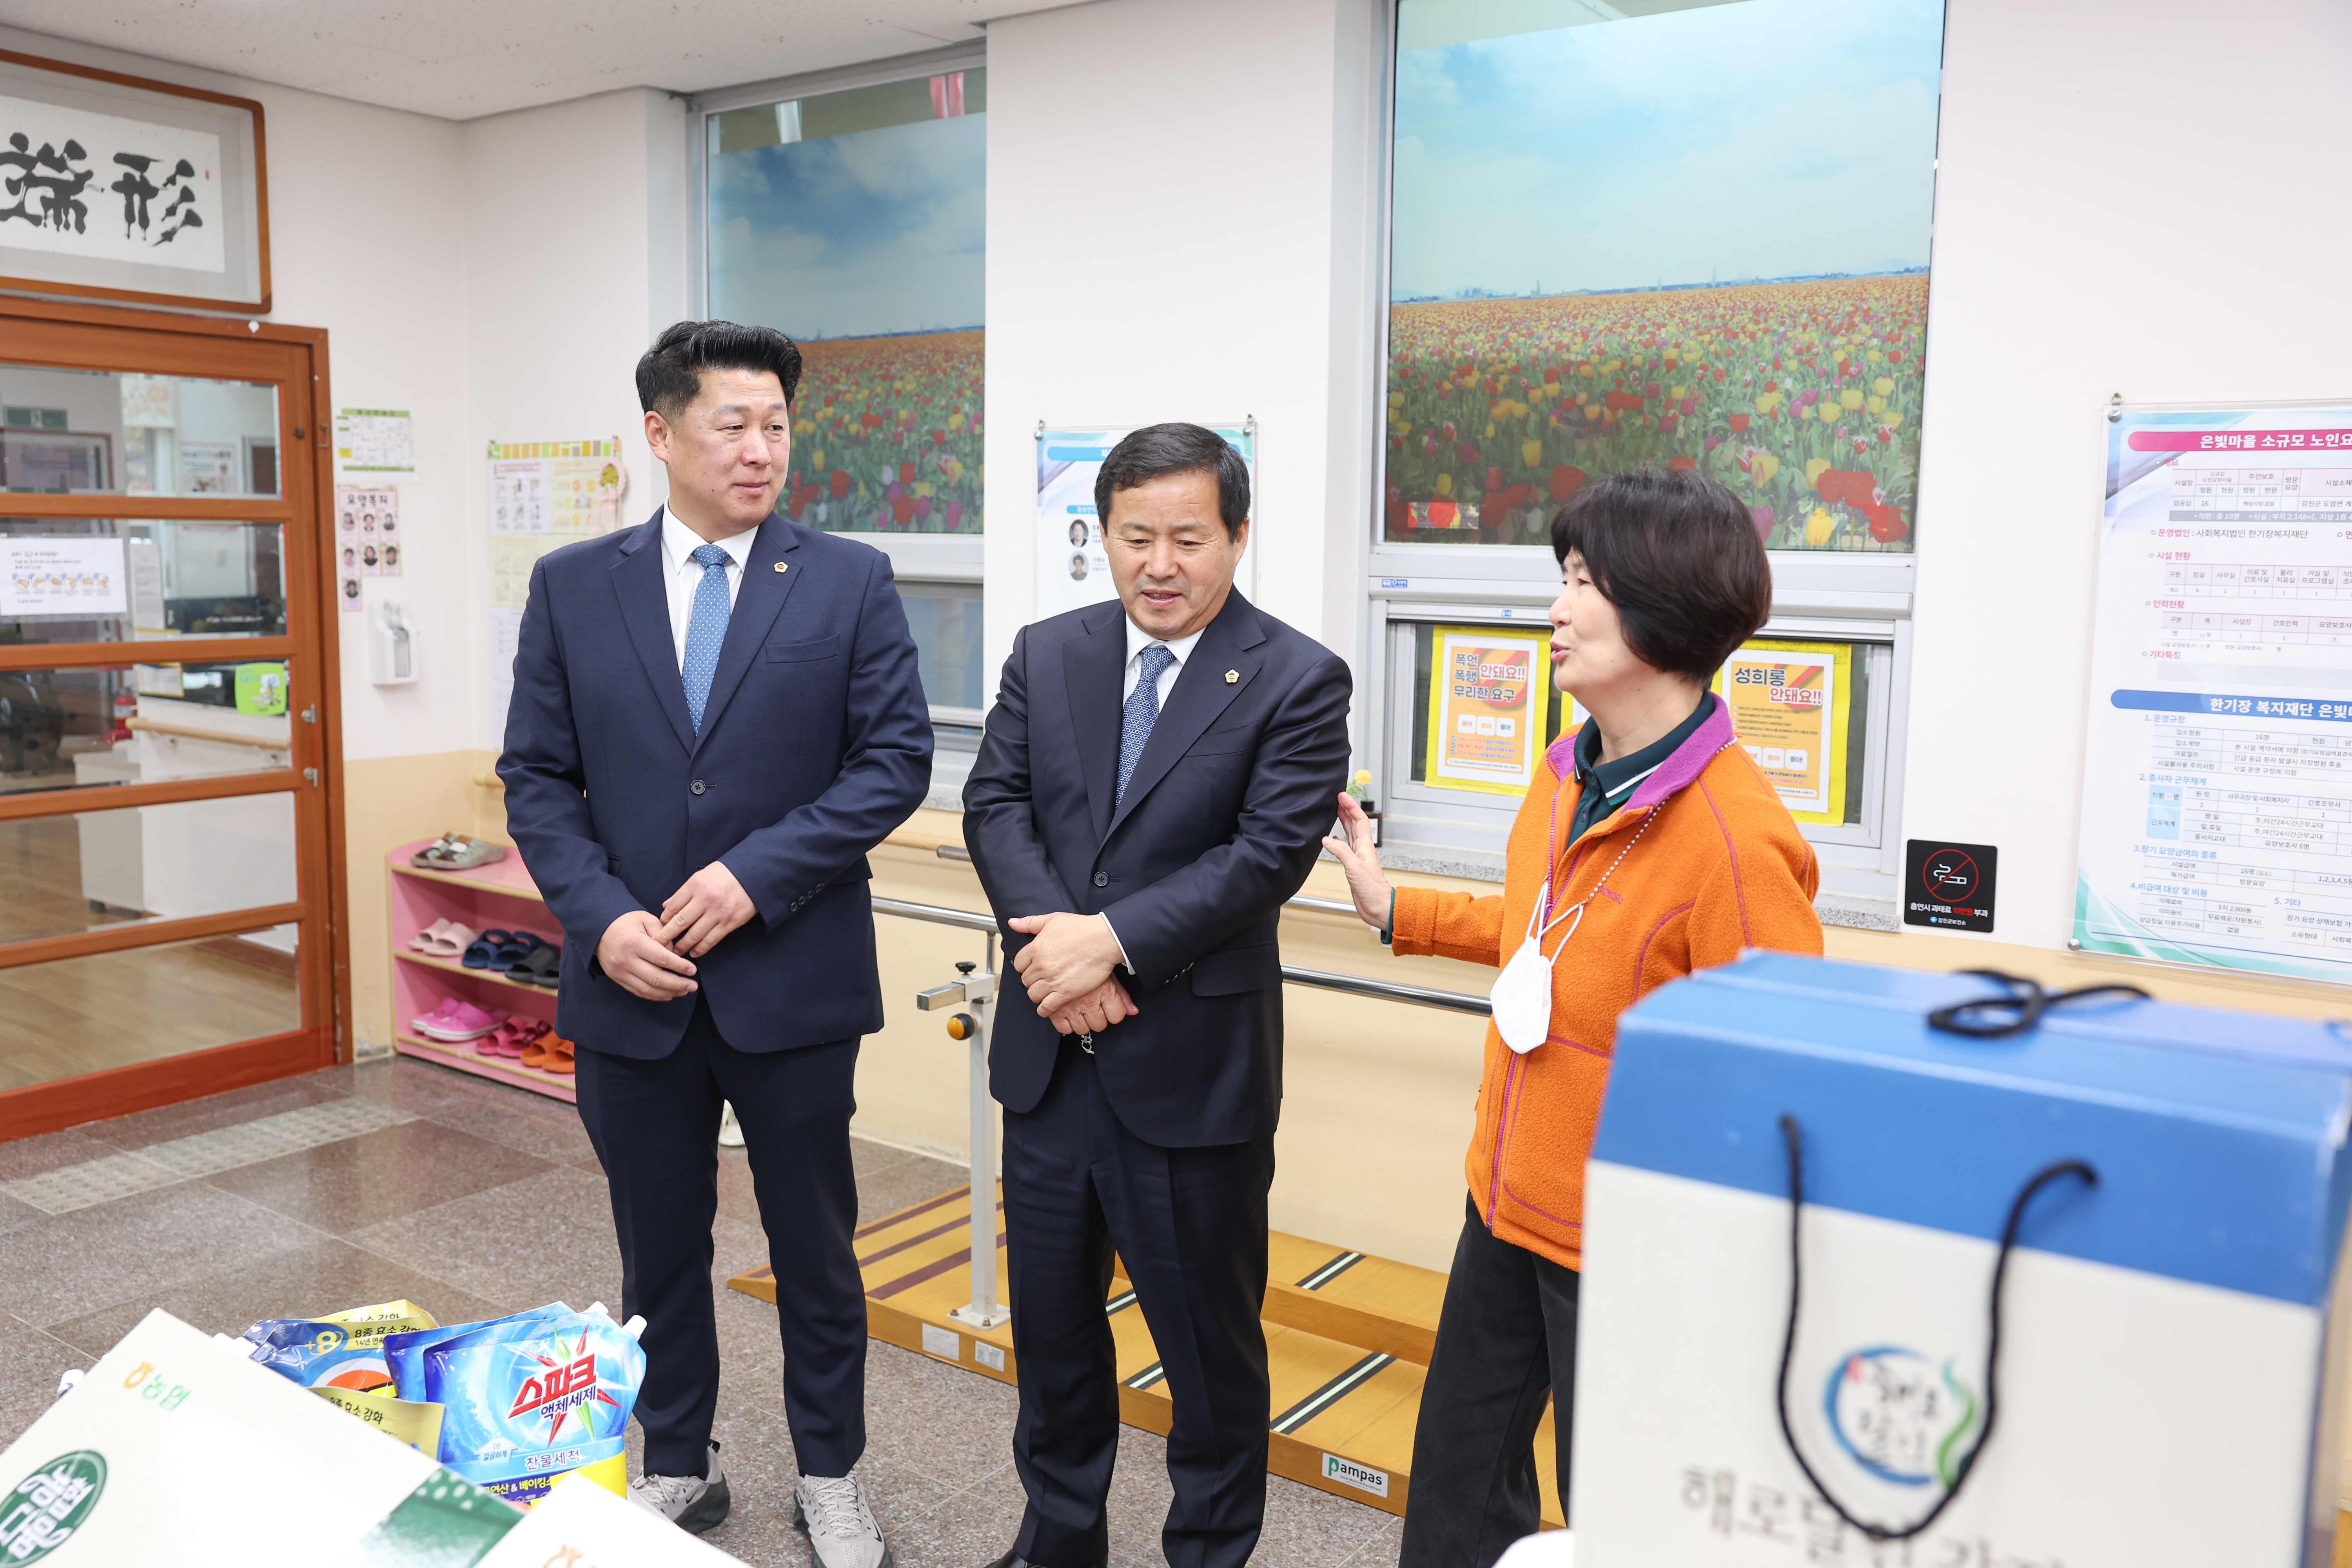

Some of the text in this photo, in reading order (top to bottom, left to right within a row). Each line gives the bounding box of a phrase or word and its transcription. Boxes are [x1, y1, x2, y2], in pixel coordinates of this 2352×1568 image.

[2200, 434, 2257, 448] 은빛마을
[2261, 434, 2305, 448] 소규모
[2158, 529, 2308, 538] 운영법인 사회복지법인 한기장복지재단
[2153, 600, 2185, 608] 인력현황
[1455, 653, 1478, 667] 폭언
[2149, 651, 2181, 659] 기타특징
[1455, 669, 1477, 682] 폭행
[1480, 665, 1525, 680] 안돼요!!
[1735, 668, 1785, 686] 성희롱
[1454, 686, 1515, 702] 무리한 요구
[1769, 688, 1822, 704] 안돼요!!
[2210, 698, 2252, 713] 한기장
[2256, 700, 2314, 717] 복지재단
[2153, 715, 2185, 724] 운영규정
[2149, 774, 2172, 782] 종사자
[2175, 776, 2207, 785] 근무체계
[2255, 818, 2324, 829] 주,야간24시간근무교대
[2195, 834, 2225, 842] 종사자교대
[2254, 829, 2323, 840] 주,야간24시간근무교대
[2159, 847, 2198, 857] 요양급여의
[2201, 851, 2216, 859] 종류
[2164, 886, 2179, 894] 대상
[2285, 898, 2301, 907] 기타
[1931, 904, 1952, 913] 과태료
[1974, 909, 1989, 918] 부과
[2165, 920, 2200, 928] 이용추가비용
[2208, 914, 2261, 926] 무료제공(자원봉사)
[355, 1328, 373, 1337] 8종
[508, 1353, 596, 1419] 스파크
[541, 1385, 596, 1420] 액체세제
[345, 1402, 383, 1425] 효소 강화
[483, 1452, 507, 1461] 깔끔하게
[525, 1449, 581, 1471] 찬물세척
[511, 1483, 518, 1492] &
